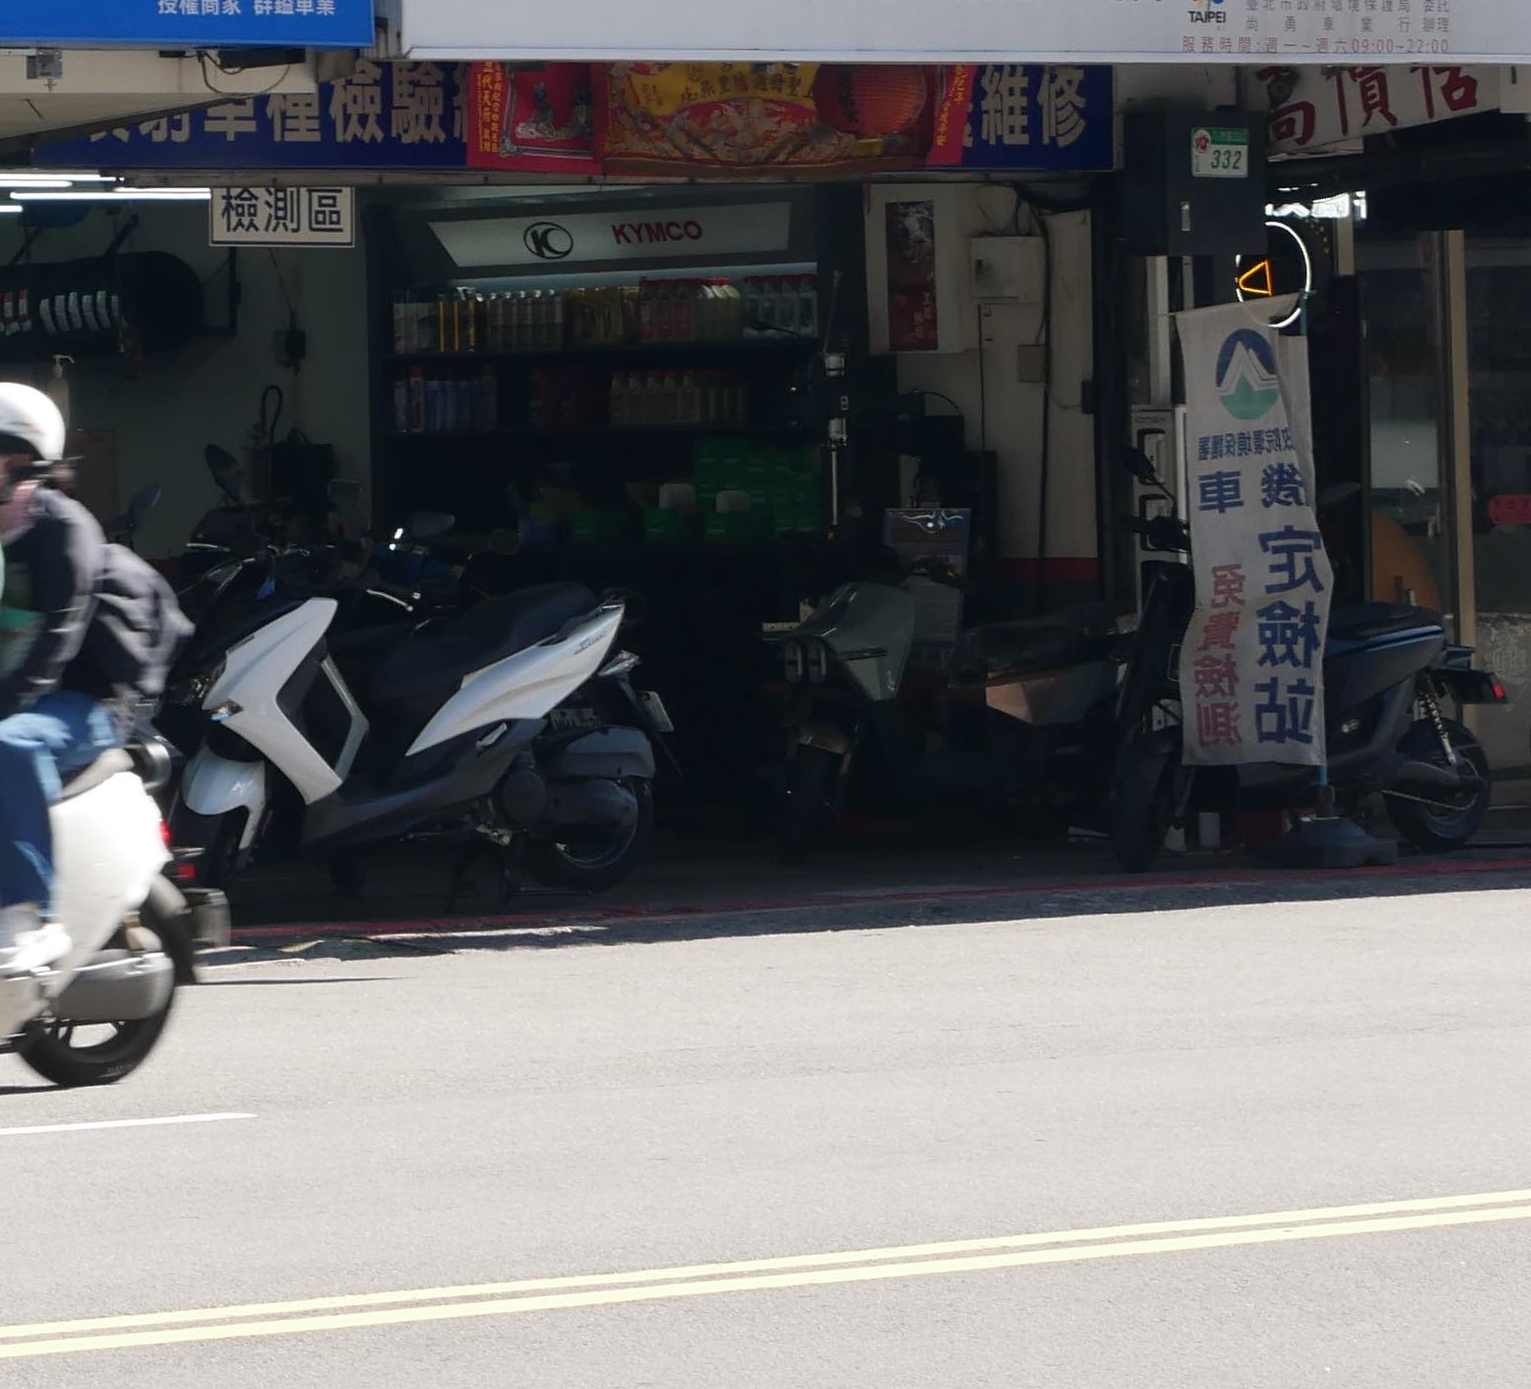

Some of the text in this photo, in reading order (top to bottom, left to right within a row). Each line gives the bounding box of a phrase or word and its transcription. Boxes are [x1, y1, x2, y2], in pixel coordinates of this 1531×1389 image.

[1188, 11, 1227, 24] TAIPEI
[1211, 149, 1242, 170] 332
[221, 187, 345, 234] 檢測區
[611, 220, 703, 245] KYMCO
